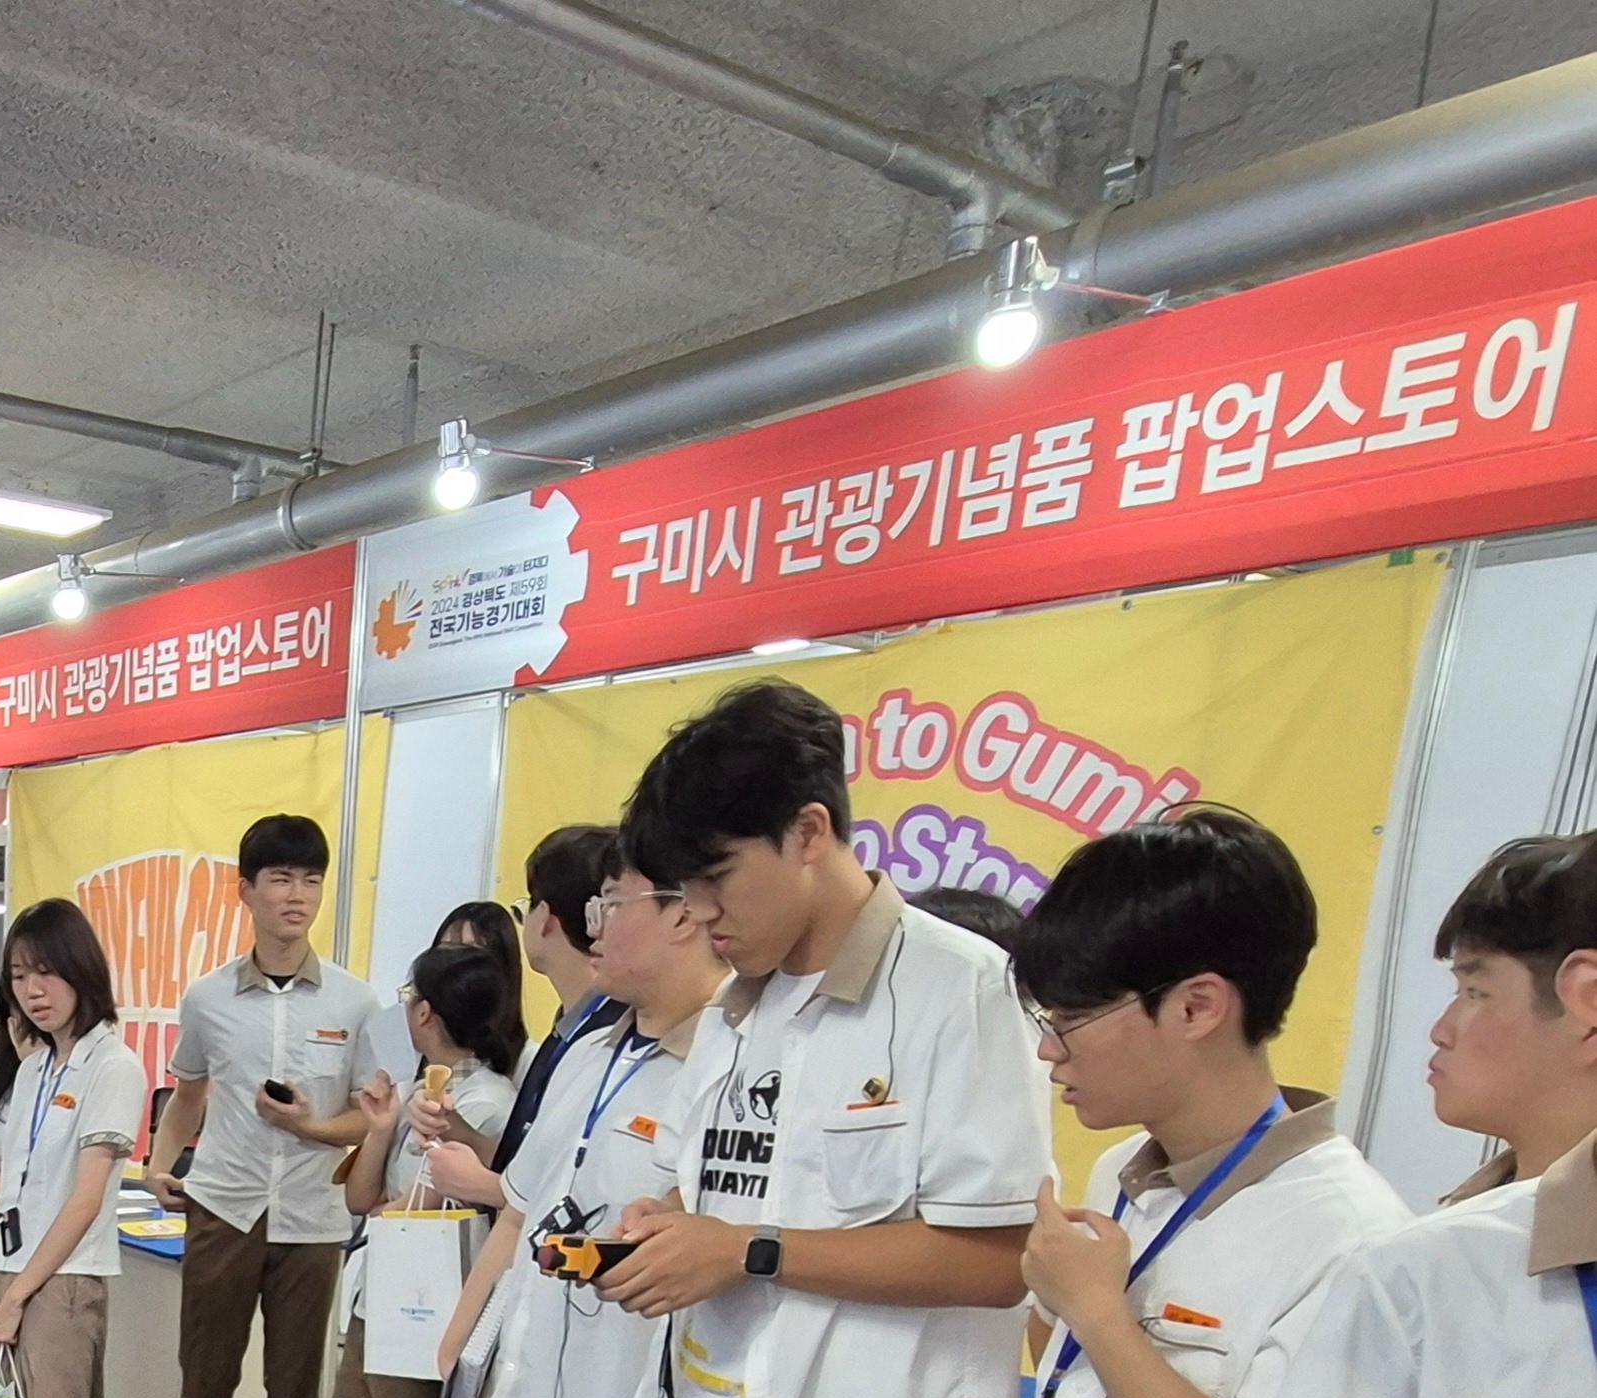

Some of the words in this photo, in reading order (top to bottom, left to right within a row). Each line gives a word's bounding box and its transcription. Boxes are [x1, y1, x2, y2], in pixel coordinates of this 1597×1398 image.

[612, 498, 761, 606] 구미시
[775, 418, 1094, 575] 관광기념품
[1116, 302, 1577, 508] 팝업스토어
[430, 595, 545, 638] 전국기능경기대회
[431, 597, 459, 615] 2024
[462, 584, 506, 608] 경상북도
[510, 574, 547, 597] 제59회
[63, 637, 180, 716] 관광기념품
[187, 600, 332, 692] 팝업스토어
[874, 698, 948, 770] to
[890, 815, 1046, 908] Stor
